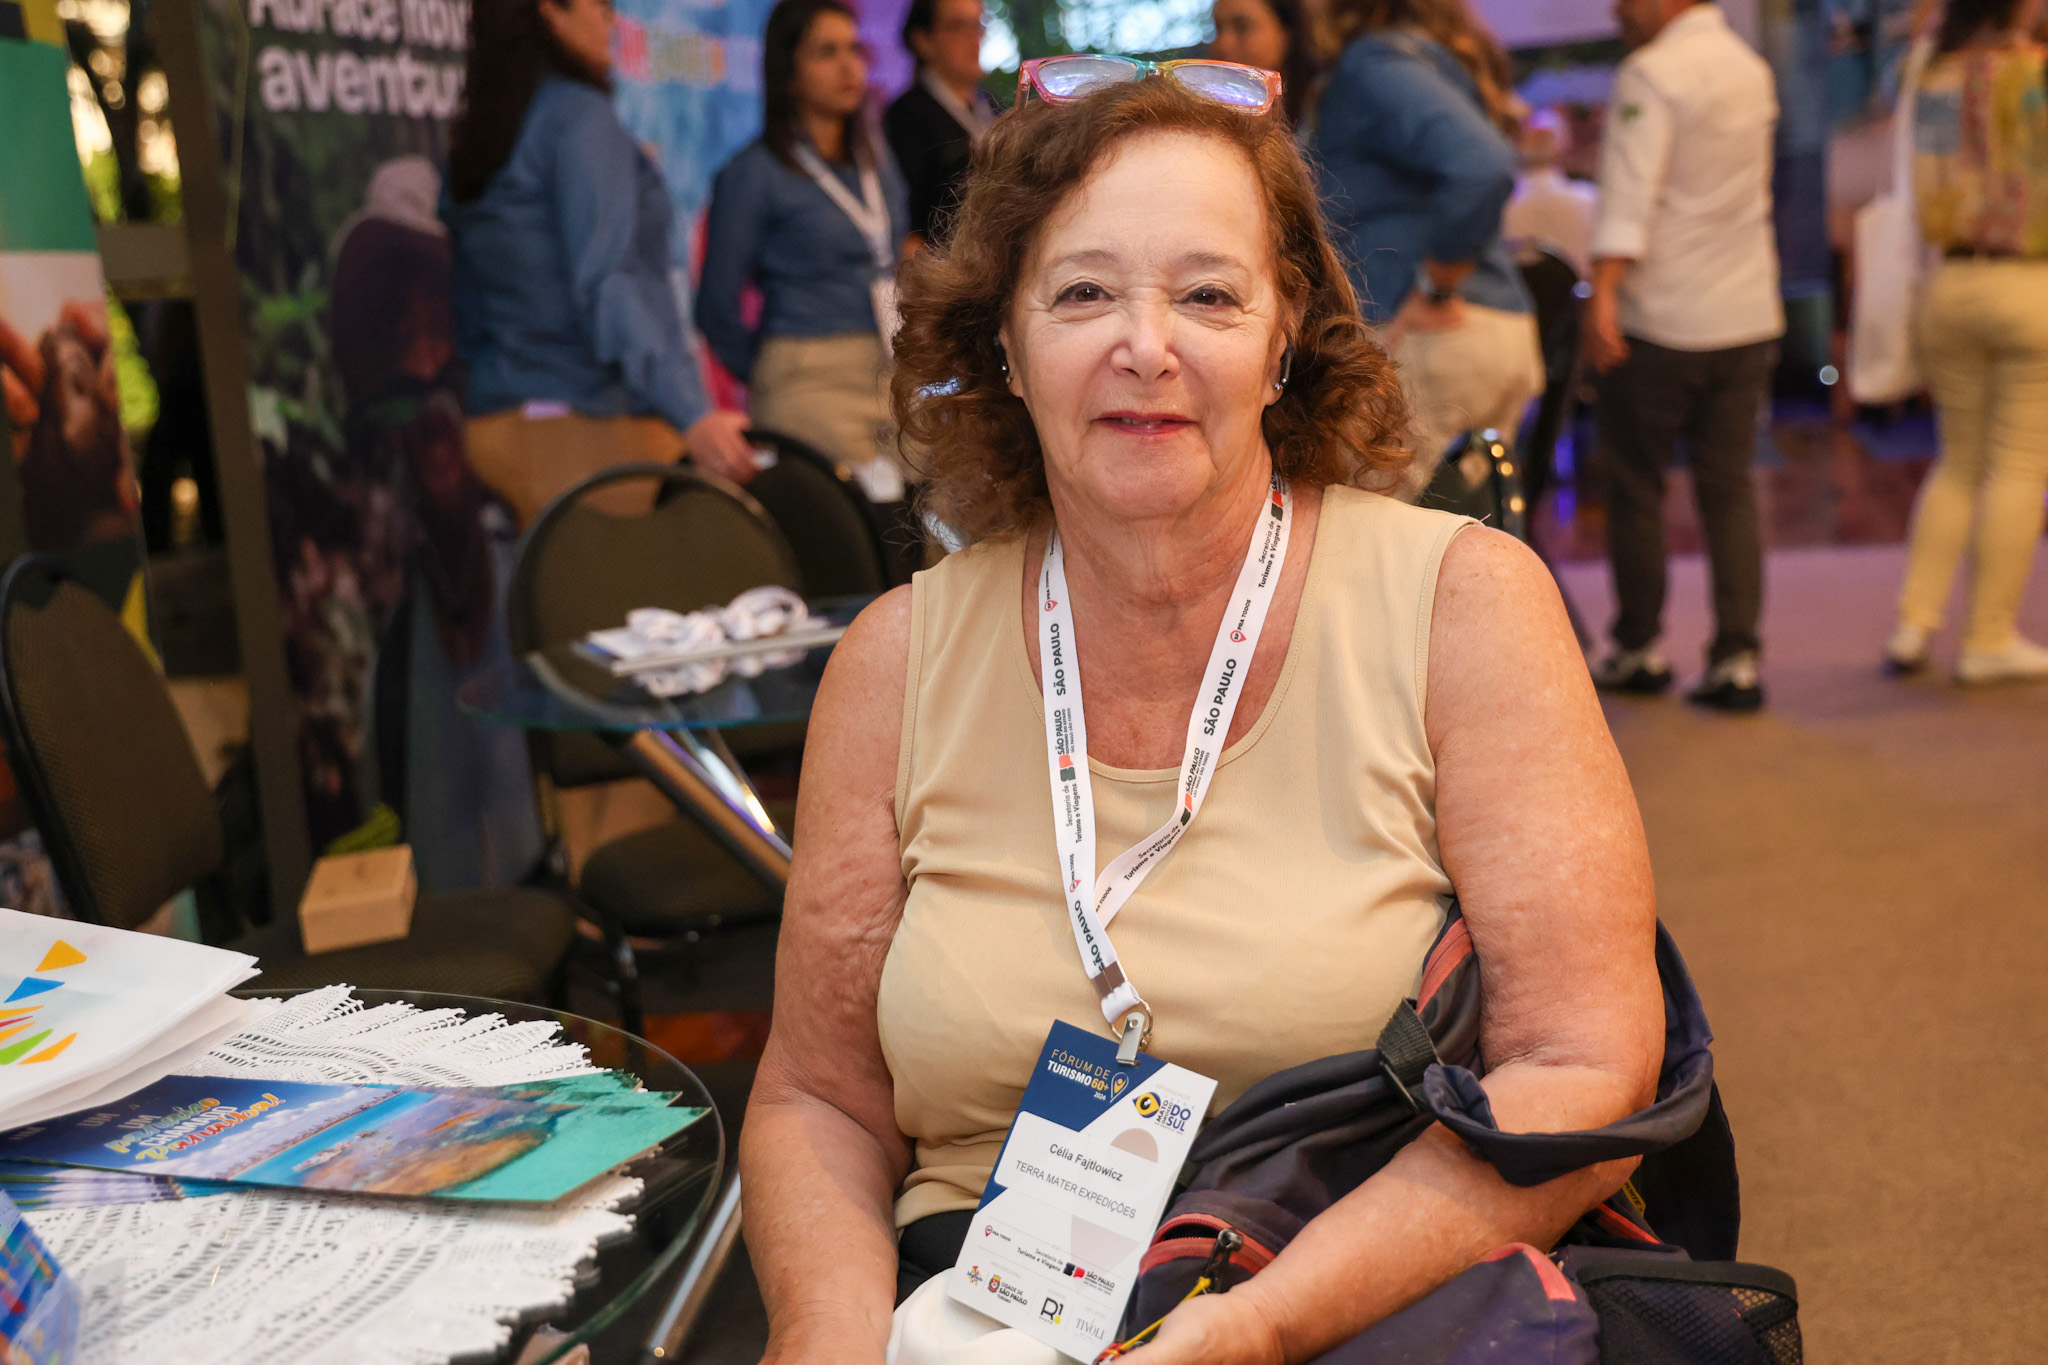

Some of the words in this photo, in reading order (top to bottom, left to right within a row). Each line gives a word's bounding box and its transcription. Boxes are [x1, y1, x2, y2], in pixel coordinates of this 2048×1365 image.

[257, 45, 470, 120] aventu
[1258, 531, 1272, 564] Secretaria
[1269, 521, 1275, 530] de
[1258, 560, 1273, 588] Turismo
[1270, 525, 1281, 551] Viagens
[1241, 599, 1251, 618] TODOS
[1050, 623, 1063, 666] PAULO
[1053, 669, 1066, 696] SÃO
[1204, 707, 1220, 736] SÃO
[1213, 658, 1236, 705] PAULO
[1054, 710, 1063, 737] PAULO
[1055, 738, 1065, 755] SÃO
[1189, 747, 1200, 775] PAULO
[1062, 785, 1069, 793] de
[1072, 783, 1080, 811] Viagens
[1065, 794, 1073, 827] Secretaria
[1123, 858, 1148, 880] Turismo
[1155, 829, 1181, 852] Viagens
[1138, 834, 1170, 858] Secretaria
[1171, 825, 1179, 834] de
[1074, 900, 1094, 944] PAULO
[1091, 944, 1106, 972] SÃO
[1051, 1049, 1093, 1072] FÓRUM
[1094, 1066, 1111, 1080] DE
[1093, 1091, 1106, 1101] 2024
[117, 1114, 162, 1129] UM
[1156, 1100, 1169, 1122] MATO
[1162, 1101, 1173, 1124] GROSSO
[1166, 1116, 1185, 1132] SUL
[1170, 1104, 1191, 1121] DO
[139, 1106, 238, 1146] CHAMADO
[1050, 1143, 1073, 1161] Célia
[1075, 1154, 1123, 1181] Fajtlowicz
[1015, 1160, 1044, 1180] TERRA
[1045, 1173, 1078, 1194] MATER
[1078, 1187, 1136, 1219] EXPEDIÇÕES
[1086, 1270, 1098, 1280] SÃO
[1098, 1276, 1115, 1289] PAULO
[999, 1287, 1010, 1297] SÃO
[1010, 1293, 1028, 1305] PAULO
